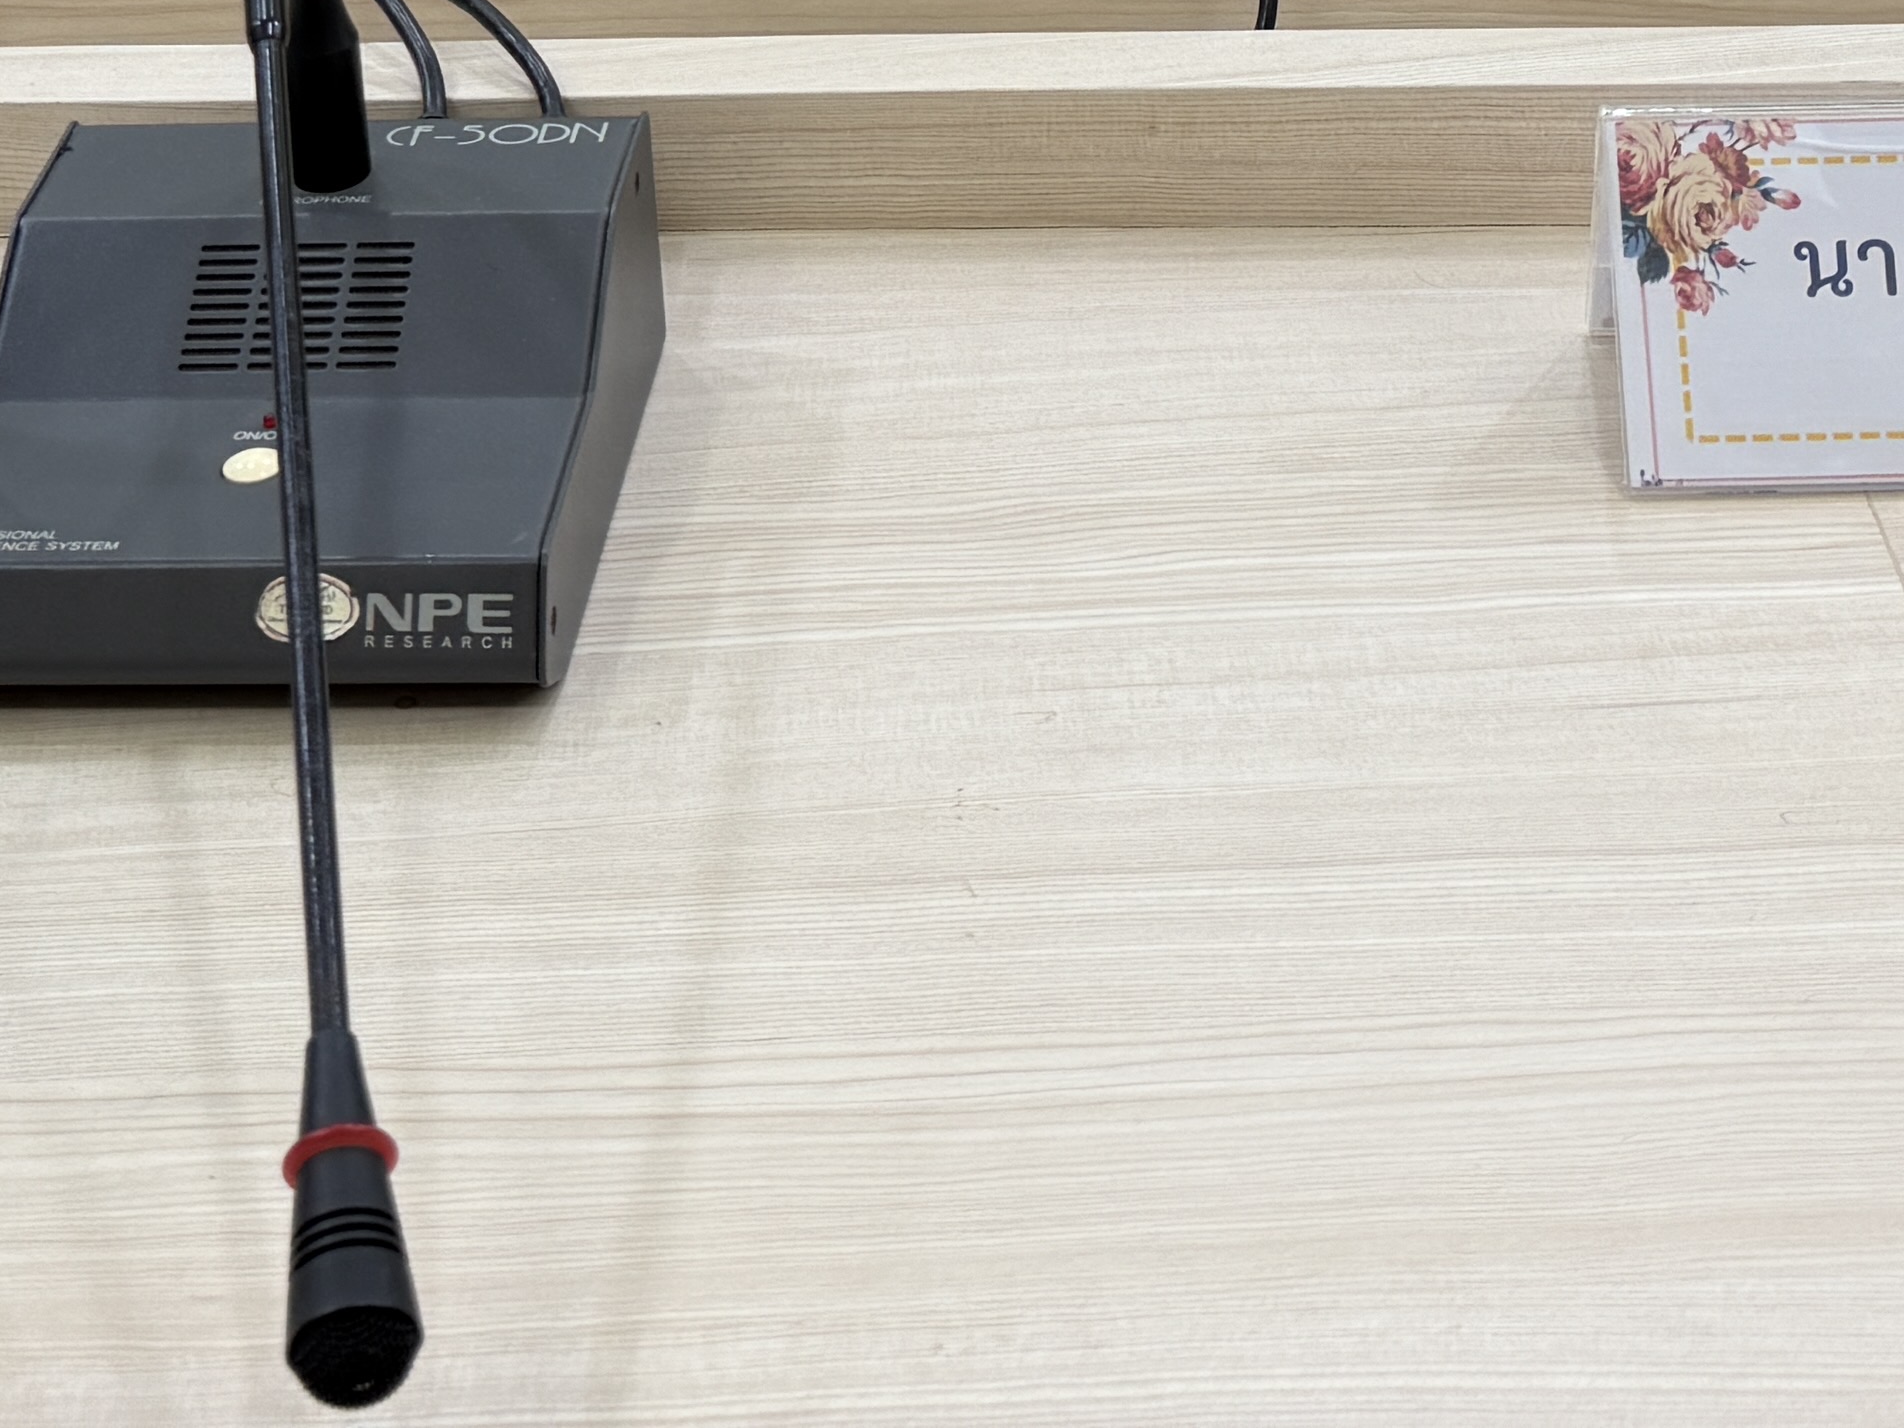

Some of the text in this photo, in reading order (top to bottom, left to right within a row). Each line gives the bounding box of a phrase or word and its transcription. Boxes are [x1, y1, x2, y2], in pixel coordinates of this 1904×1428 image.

[386, 121, 609, 147] CF-50DN
[259, 194, 372, 207] ROPHONE
[44, 540, 121, 552] SYSTEM
[364, 591, 513, 634] NPE
[364, 634, 514, 650] RESEARCH
